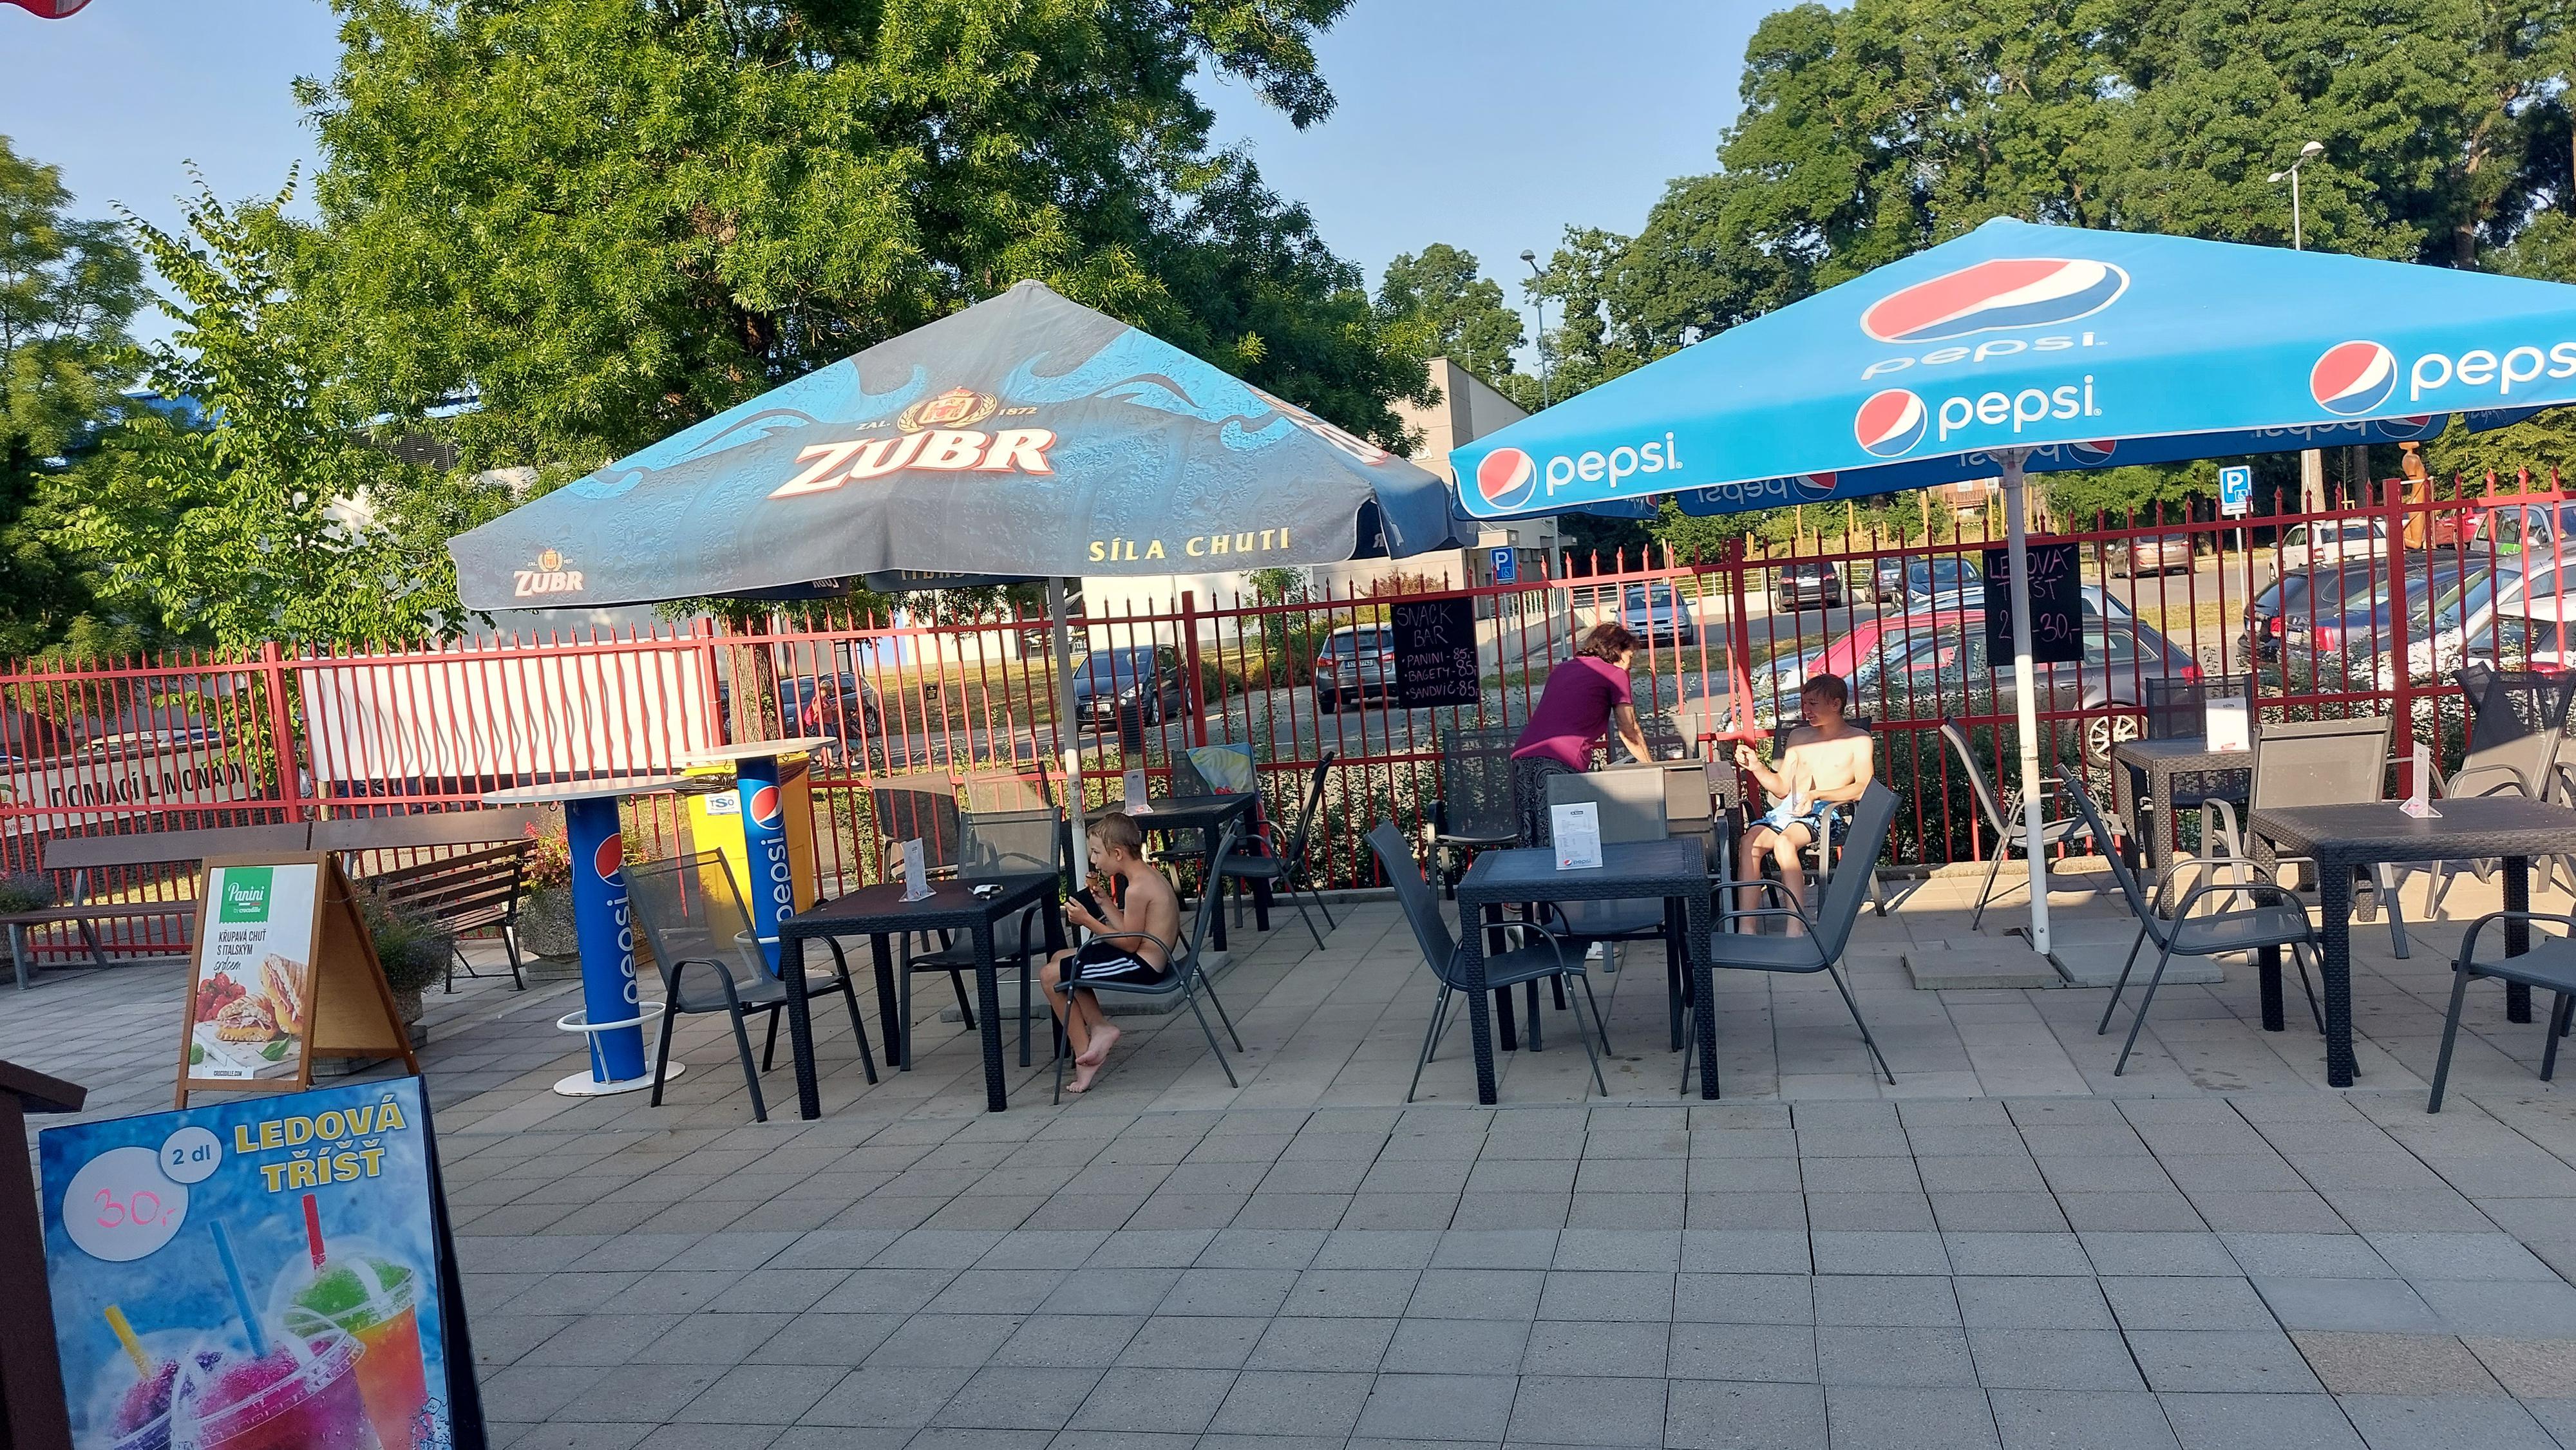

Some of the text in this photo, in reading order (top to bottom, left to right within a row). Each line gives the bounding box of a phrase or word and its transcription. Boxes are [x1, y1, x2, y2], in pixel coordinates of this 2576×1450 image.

[1861, 332, 2096, 381] pepsi
[999, 406, 1038, 416] 1872
[1939, 374, 2094, 442] pepsi
[768, 428, 1057, 500] ZUBR
[1546, 431, 1674, 496] pepsi
[2227, 471, 2244, 493] P
[1088, 527, 1289, 561] SÍLA CHUTI
[1495, 552, 1508, 570] P
[1989, 546, 2072, 578] LEOVÁ
[513, 570, 583, 596] ZUBR
[1396, 603, 1453, 626] SNACK
[1414, 625, 1448, 648] BAR
[1407, 651, 1444, 668] PANINI
[710, 798, 734, 807] TSO
[228, 882, 265, 901] Panini
[219, 928, 267, 942] KŘUPAVÁ CHUŤ
[217, 943, 253, 956] S ITALSKÝM
[234, 1094, 407, 1154] LEDOVÁ
[172, 1144, 211, 1165] 2 dl
[260, 1138, 385, 1192] TŘÍŠŤ
[94, 1188, 176, 1229] 30,-
